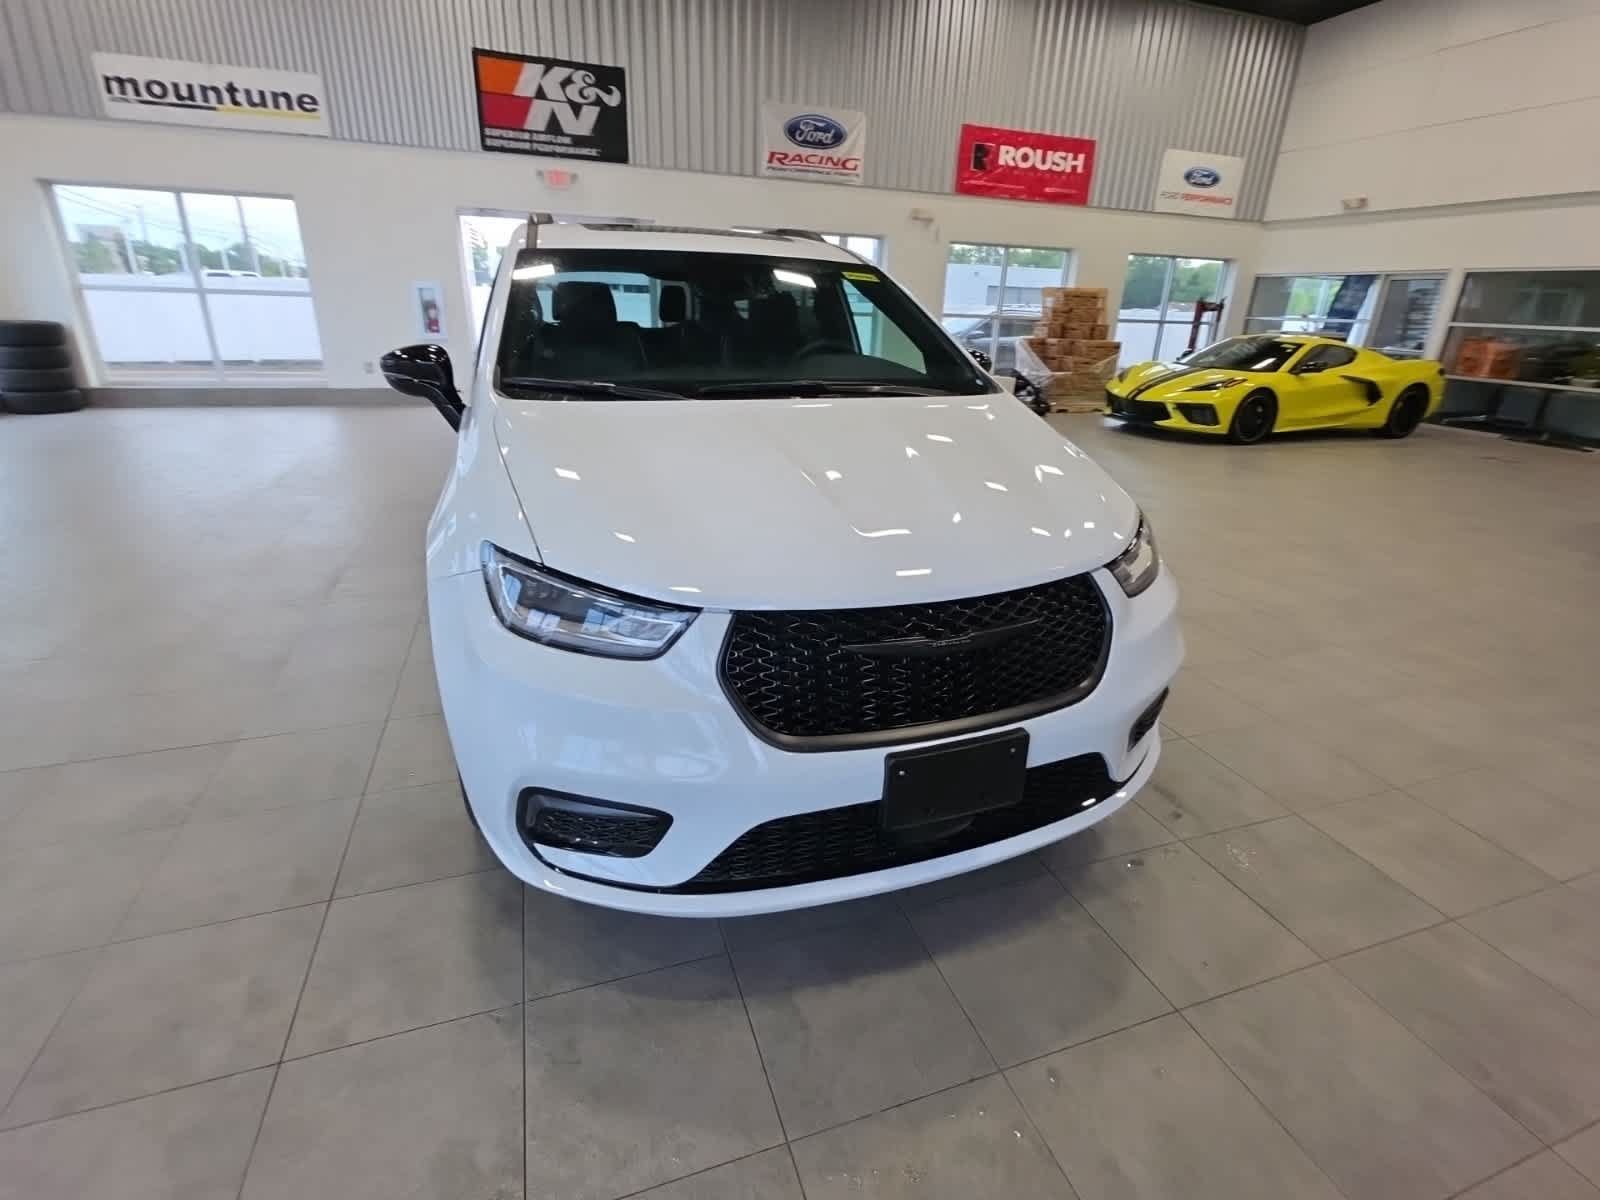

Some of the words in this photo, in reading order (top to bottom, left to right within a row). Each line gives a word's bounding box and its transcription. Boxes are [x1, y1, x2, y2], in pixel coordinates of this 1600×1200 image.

[102, 73, 319, 113] mountune
[795, 119, 836, 145] Ford
[767, 151, 861, 172] RACING
[997, 144, 1086, 174] ROUSH
